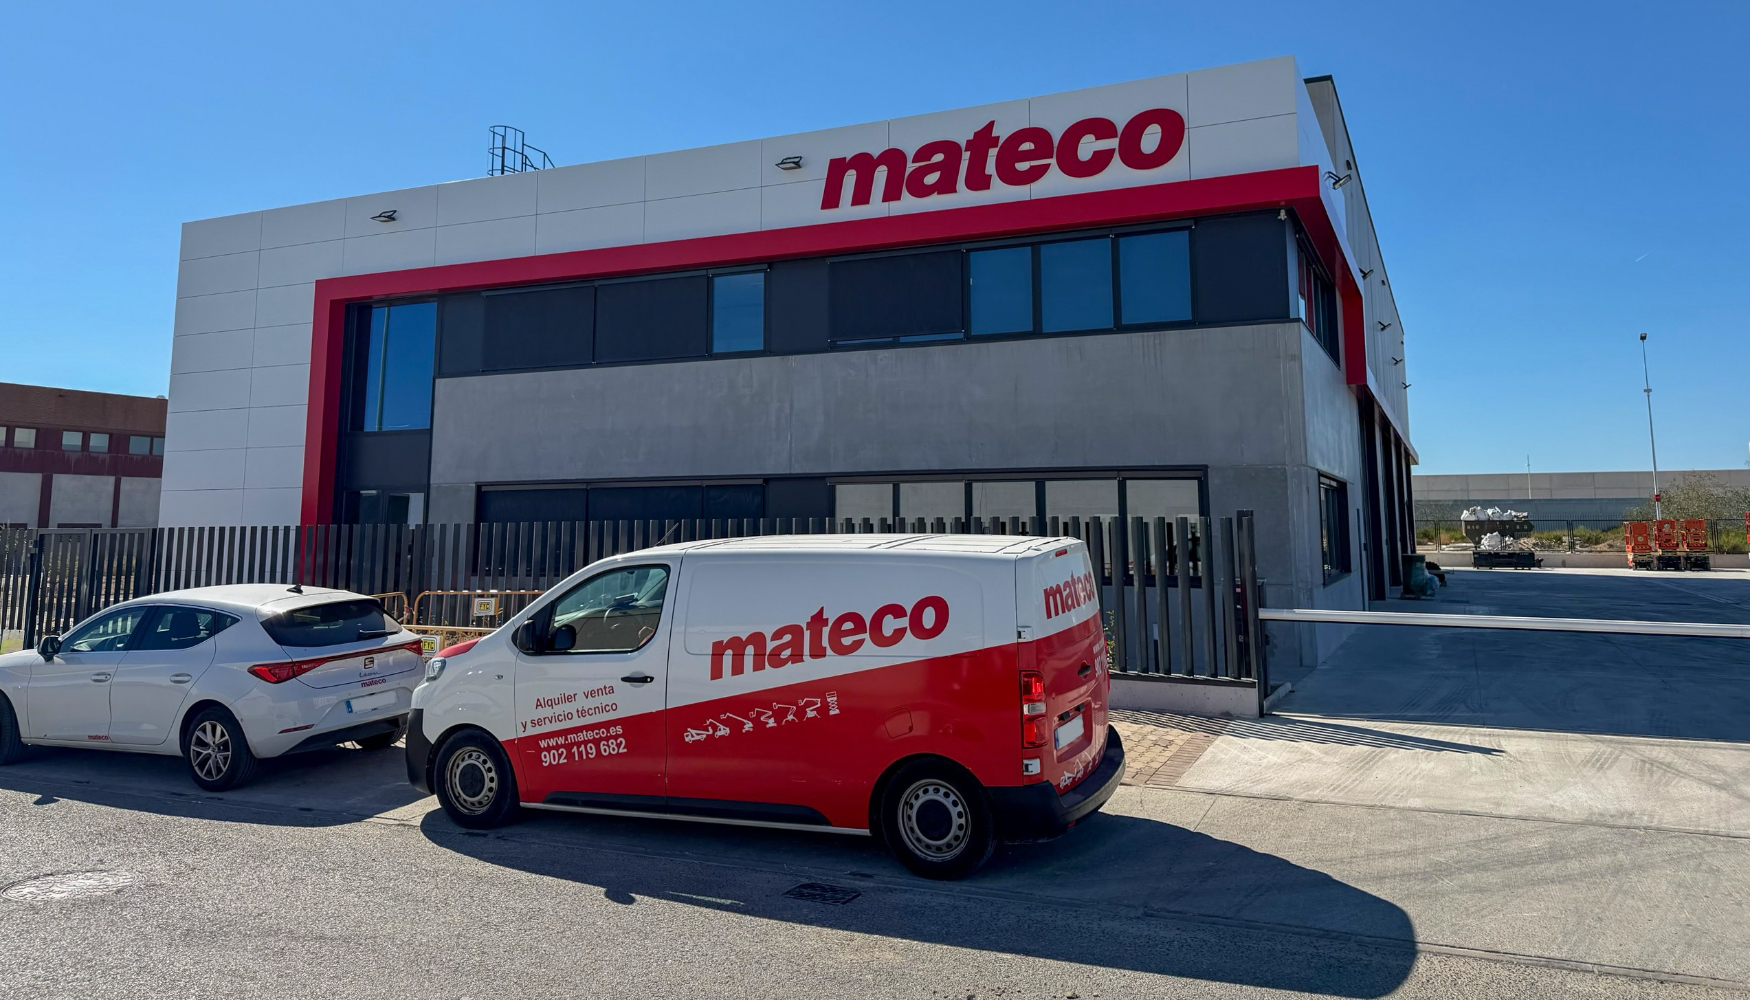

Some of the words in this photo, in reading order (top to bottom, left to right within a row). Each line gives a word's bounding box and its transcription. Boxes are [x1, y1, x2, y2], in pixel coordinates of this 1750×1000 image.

[820, 107, 1185, 210] mateco
[1043, 570, 1095, 620] mateco
[709, 595, 949, 681] mateco
[361, 678, 387, 688] mateco
[535, 692, 578, 710] Alquiler
[583, 685, 615, 700] venta
[521, 720, 527, 733] y
[530, 710, 574, 728] servicio
[576, 702, 618, 719] técnico
[538, 725, 623, 749] www.mateco.es
[541, 748, 568, 767] 902
[571, 743, 597, 761] 119
[600, 737, 628, 756] 682
